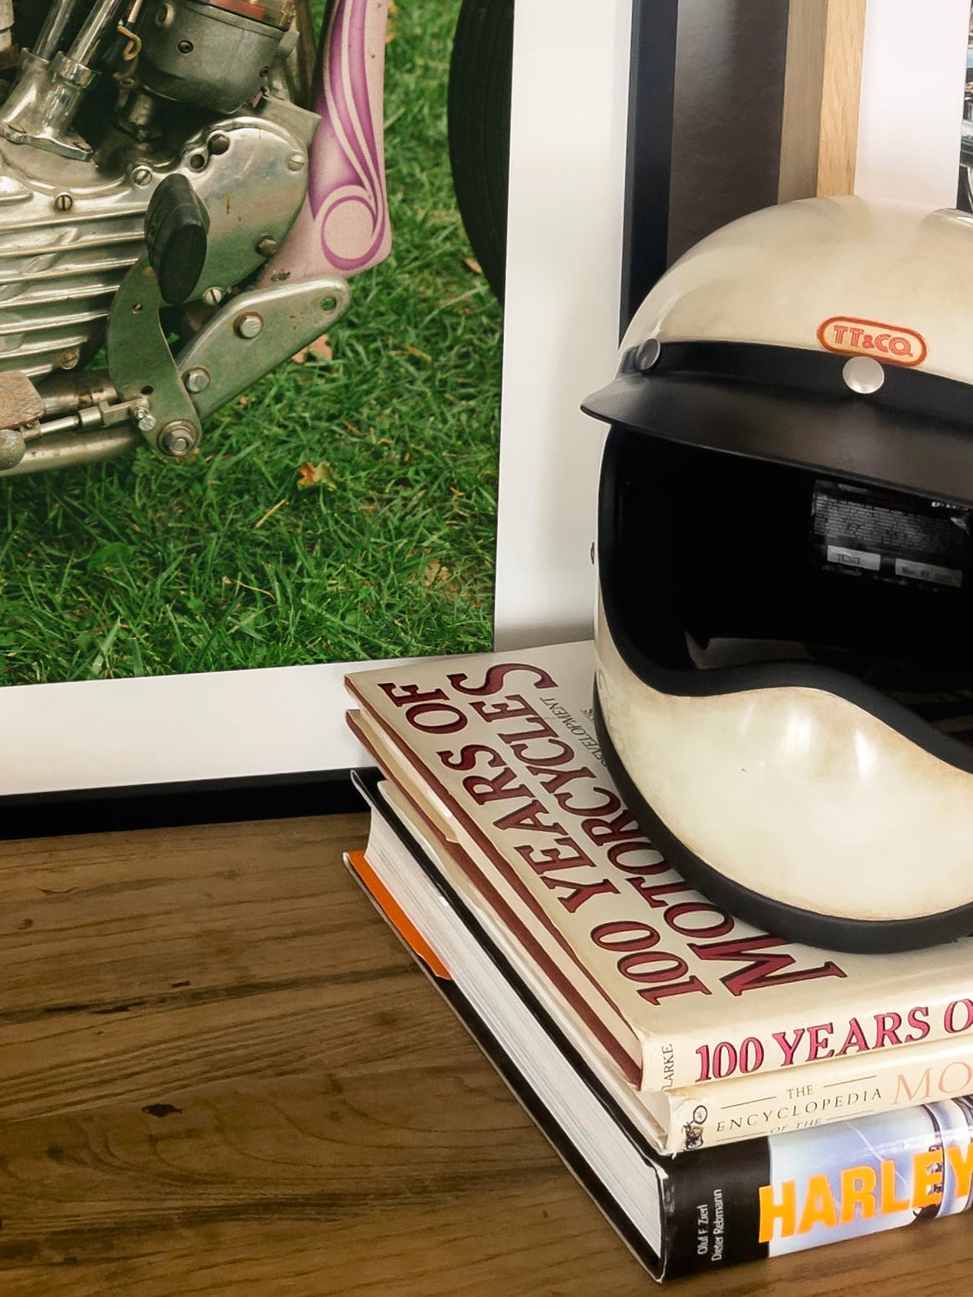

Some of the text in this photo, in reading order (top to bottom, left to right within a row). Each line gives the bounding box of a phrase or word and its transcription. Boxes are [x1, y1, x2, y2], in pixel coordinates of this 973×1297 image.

[377, 682, 713, 1006] 100 YEARS OF
[446, 662, 848, 996] MOTORCYCLES
[695, 1036, 764, 1083] 100
[772, 1006, 930, 1067] YEARS
[716, 1087, 882, 1133] ENCYCLOPEDIA
[786, 1084, 814, 1100] THE
[713, 1189, 724, 1235] Rebmann
[758, 1141, 973, 1244] HARLEY
